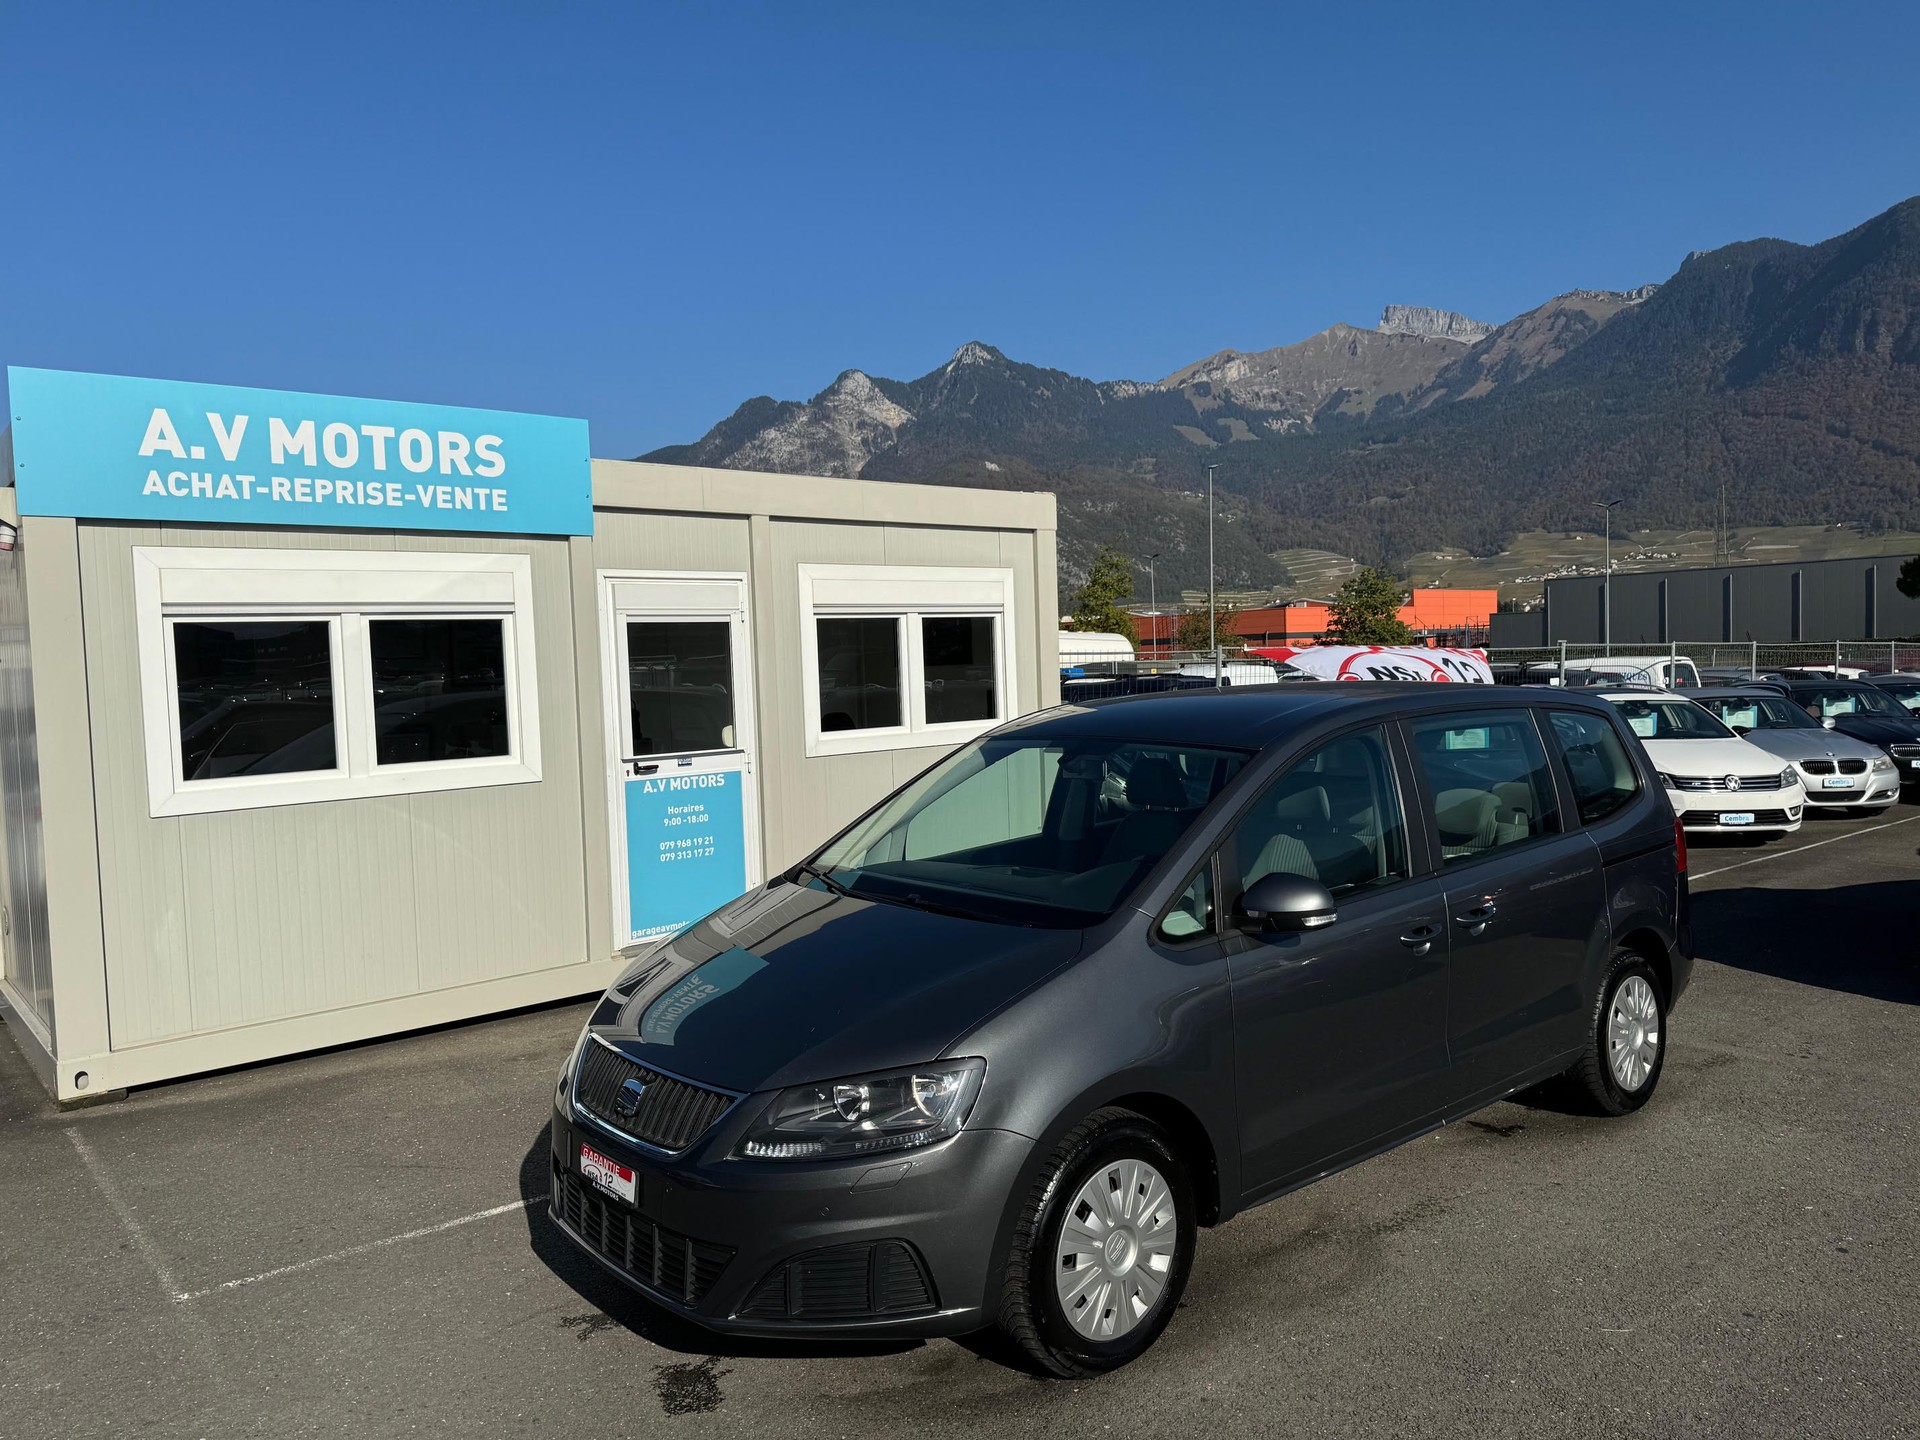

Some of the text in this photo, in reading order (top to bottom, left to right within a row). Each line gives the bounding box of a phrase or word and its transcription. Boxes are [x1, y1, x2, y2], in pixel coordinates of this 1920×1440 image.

[138, 408, 506, 477] A.V MOTORS
[142, 470, 508, 511] ACHAT-REPRISE-VENTE
[643, 774, 725, 793] A.V MOTORS
[667, 804, 704, 815] Horaires
[663, 817, 682, 827] 9:00
[660, 836, 714, 851] 079 968 19 21
[660, 847, 714, 862] 079 313 17 27
[582, 1147, 620, 1177] GARANTIE
[603, 1172, 614, 1188] 12
